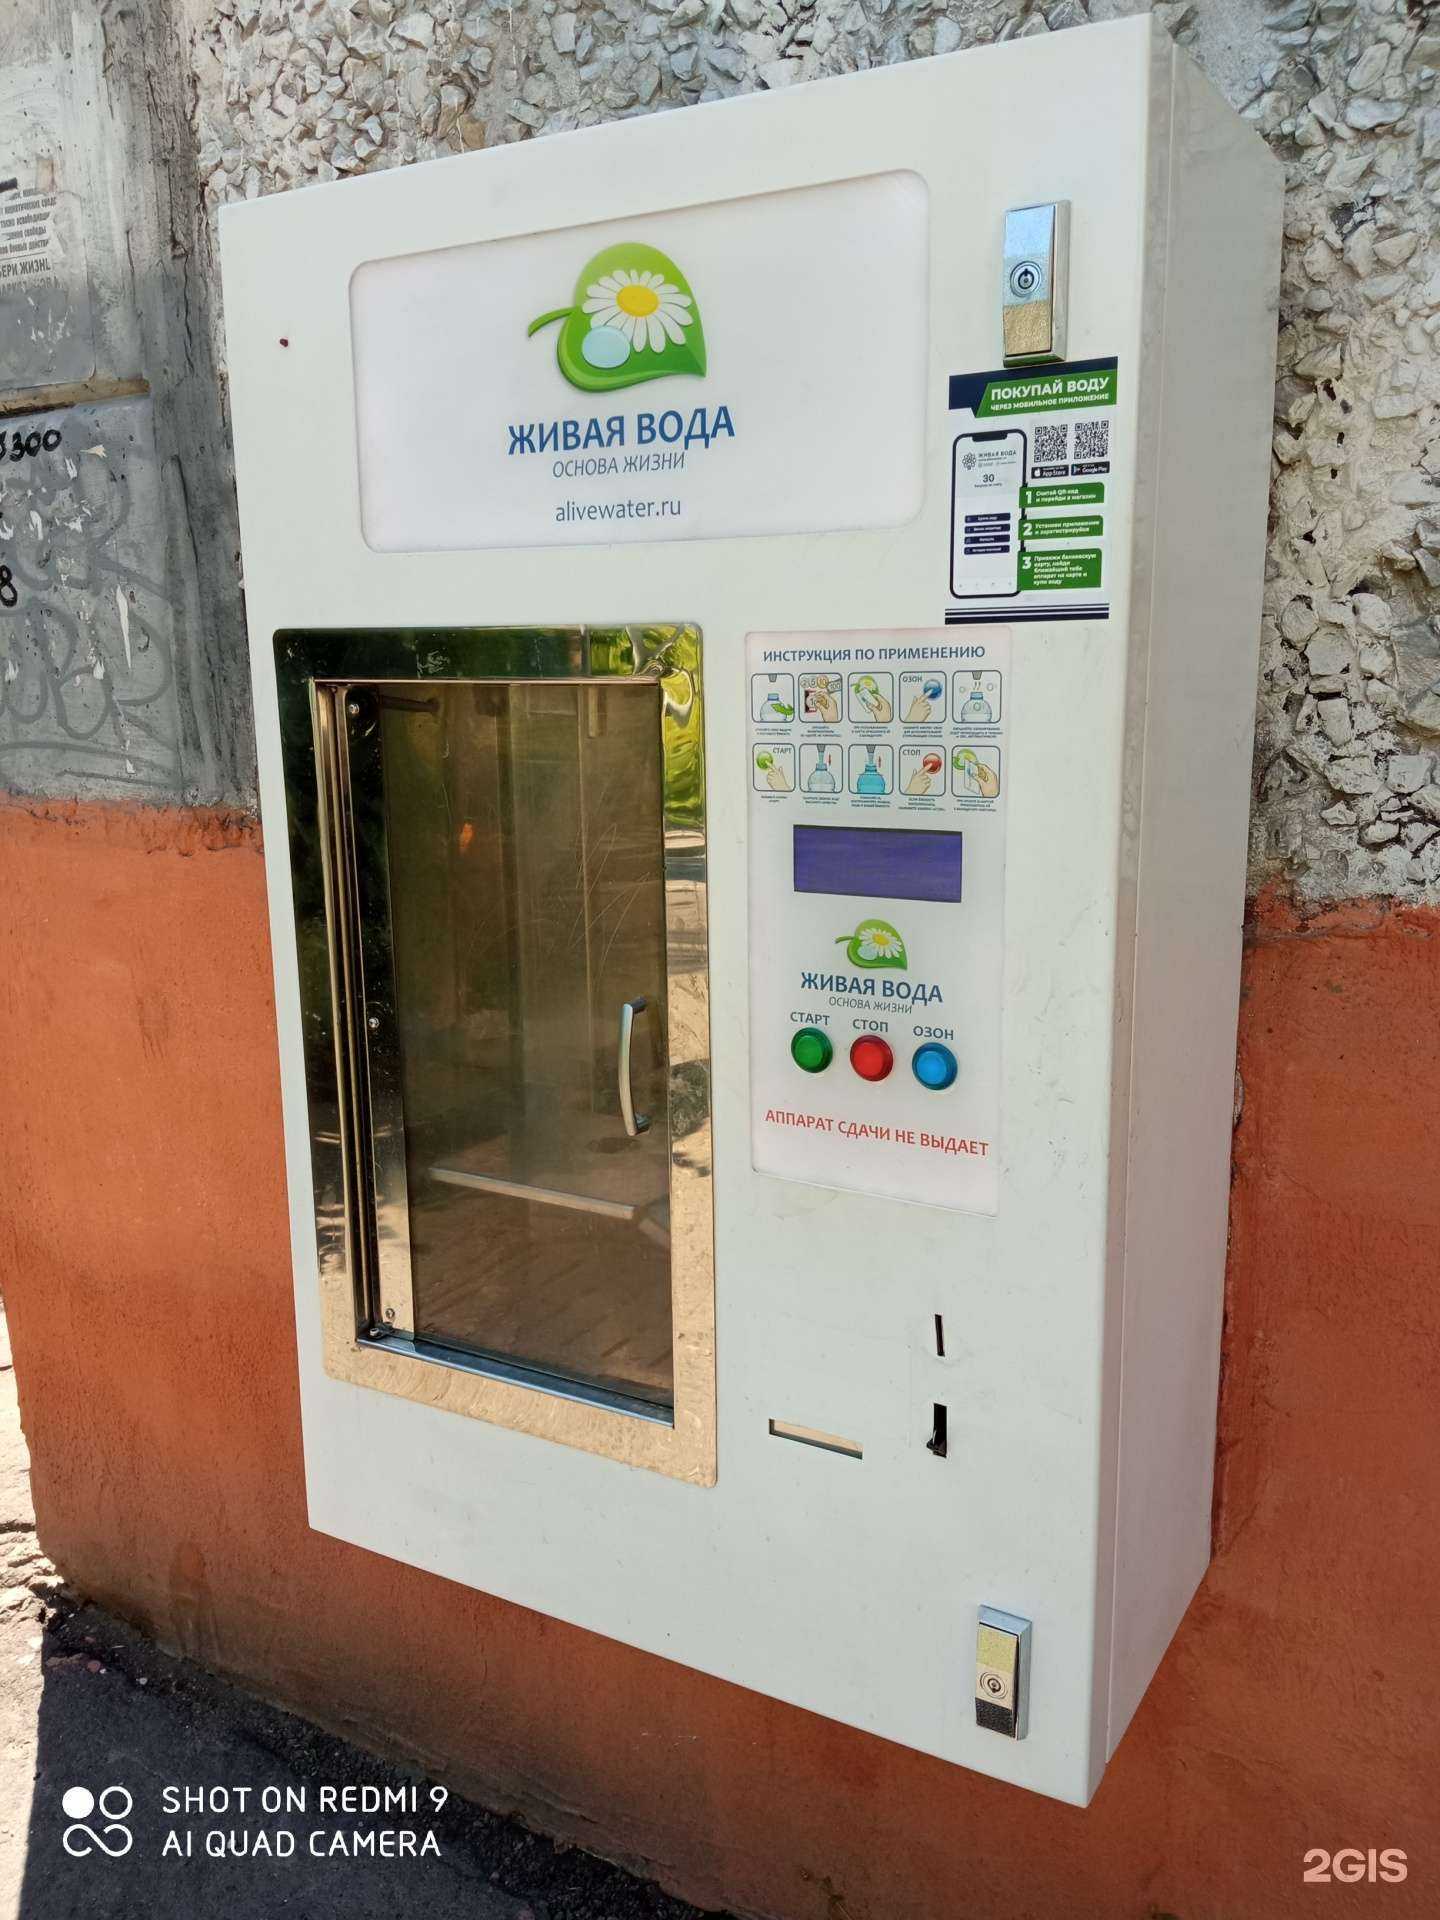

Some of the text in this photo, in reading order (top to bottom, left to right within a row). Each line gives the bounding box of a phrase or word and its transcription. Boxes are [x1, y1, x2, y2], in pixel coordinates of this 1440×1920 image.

[991, 376, 1110, 401] ПОКУПАЙ ВОДУ
[990, 393, 1109, 411] ЧЕРЕЗ МОБИЛЬНОЕ ПРИЛОЖЕНИЕ
[508, 405, 736, 455] ЖИВАЯ ВОДА
[552, 451, 686, 478] ОСНОВА ЖИЗНИ
[982, 474, 995, 483] 30
[1025, 490, 1032, 504] 1
[556, 499, 681, 522] alivewater.ru
[1023, 522, 1033, 536] 2
[1022, 556, 1032, 569] 3
[763, 646, 985, 664] ИНСТРУКЦИЯ ПО ПРИМЕНЕНИЮ
[902, 675, 922, 683] ОЗОН
[772, 746, 792, 755] СТАРТ
[902, 748, 921, 756] СТОП
[801, 972, 943, 1006] ЖИВАЯ ВОДА
[828, 996, 913, 1014] ОСНОВА ЖИЗНИ
[790, 1011, 830, 1026] СТАРТ
[852, 1018, 889, 1033] СТОП
[913, 1026, 954, 1041] ОЗОН
[765, 1109, 989, 1156] АППАРАТ СДАЧИ НЕ ВЫДАЕТ
